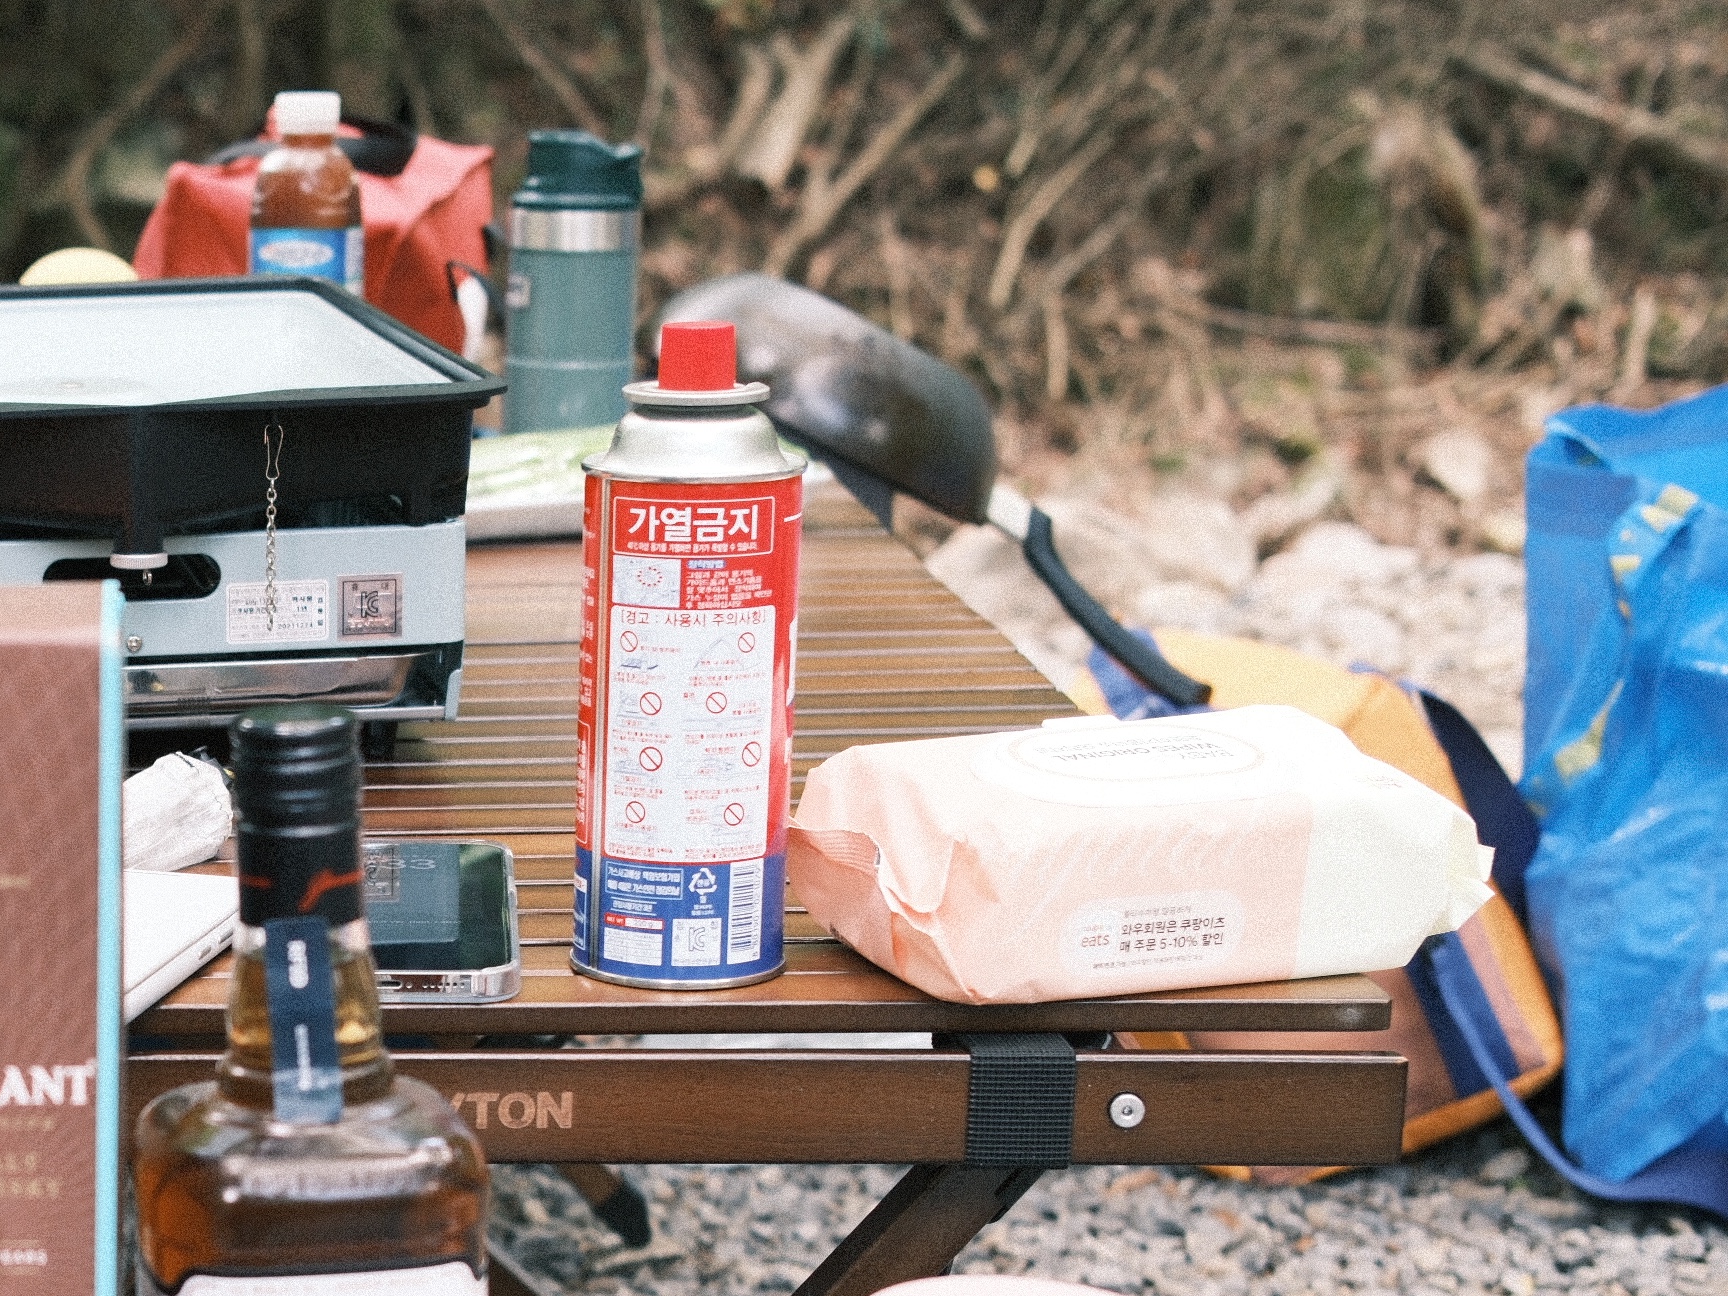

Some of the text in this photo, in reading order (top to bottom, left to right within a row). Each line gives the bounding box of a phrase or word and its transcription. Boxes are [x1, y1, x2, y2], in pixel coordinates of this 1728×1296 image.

[628, 504, 759, 542] 가열금지
[665, 613, 706, 627] 사용시
[1122, 920, 1177, 936] 와우회원은
[1179, 917, 1225, 932] 쿠팡이츠
[689, 926, 706, 952] KC
[1081, 934, 1110, 948] eats
[1120, 932, 1224, 952] 매 주문 5-10% 할인
